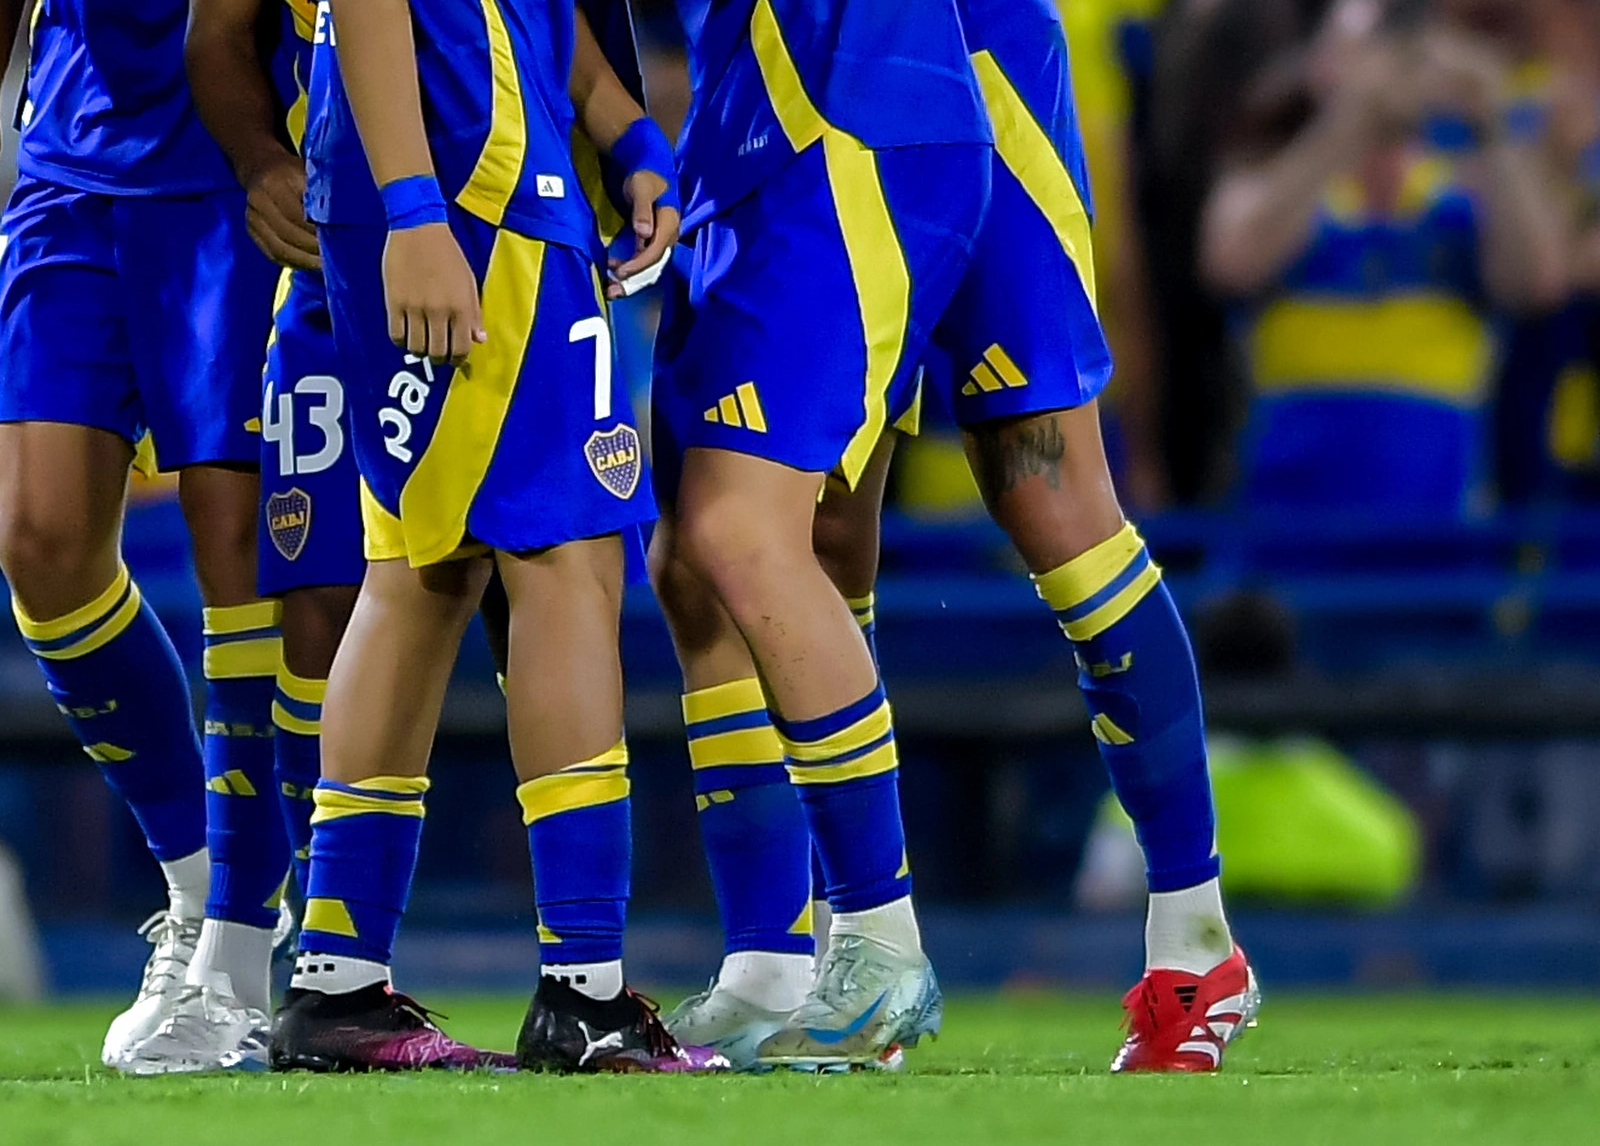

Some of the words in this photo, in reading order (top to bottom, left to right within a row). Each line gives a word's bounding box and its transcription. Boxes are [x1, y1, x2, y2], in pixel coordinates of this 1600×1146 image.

[568, 316, 611, 420] 7
[262, 375, 343, 476] 43
[596, 446, 635, 471] CABJ
